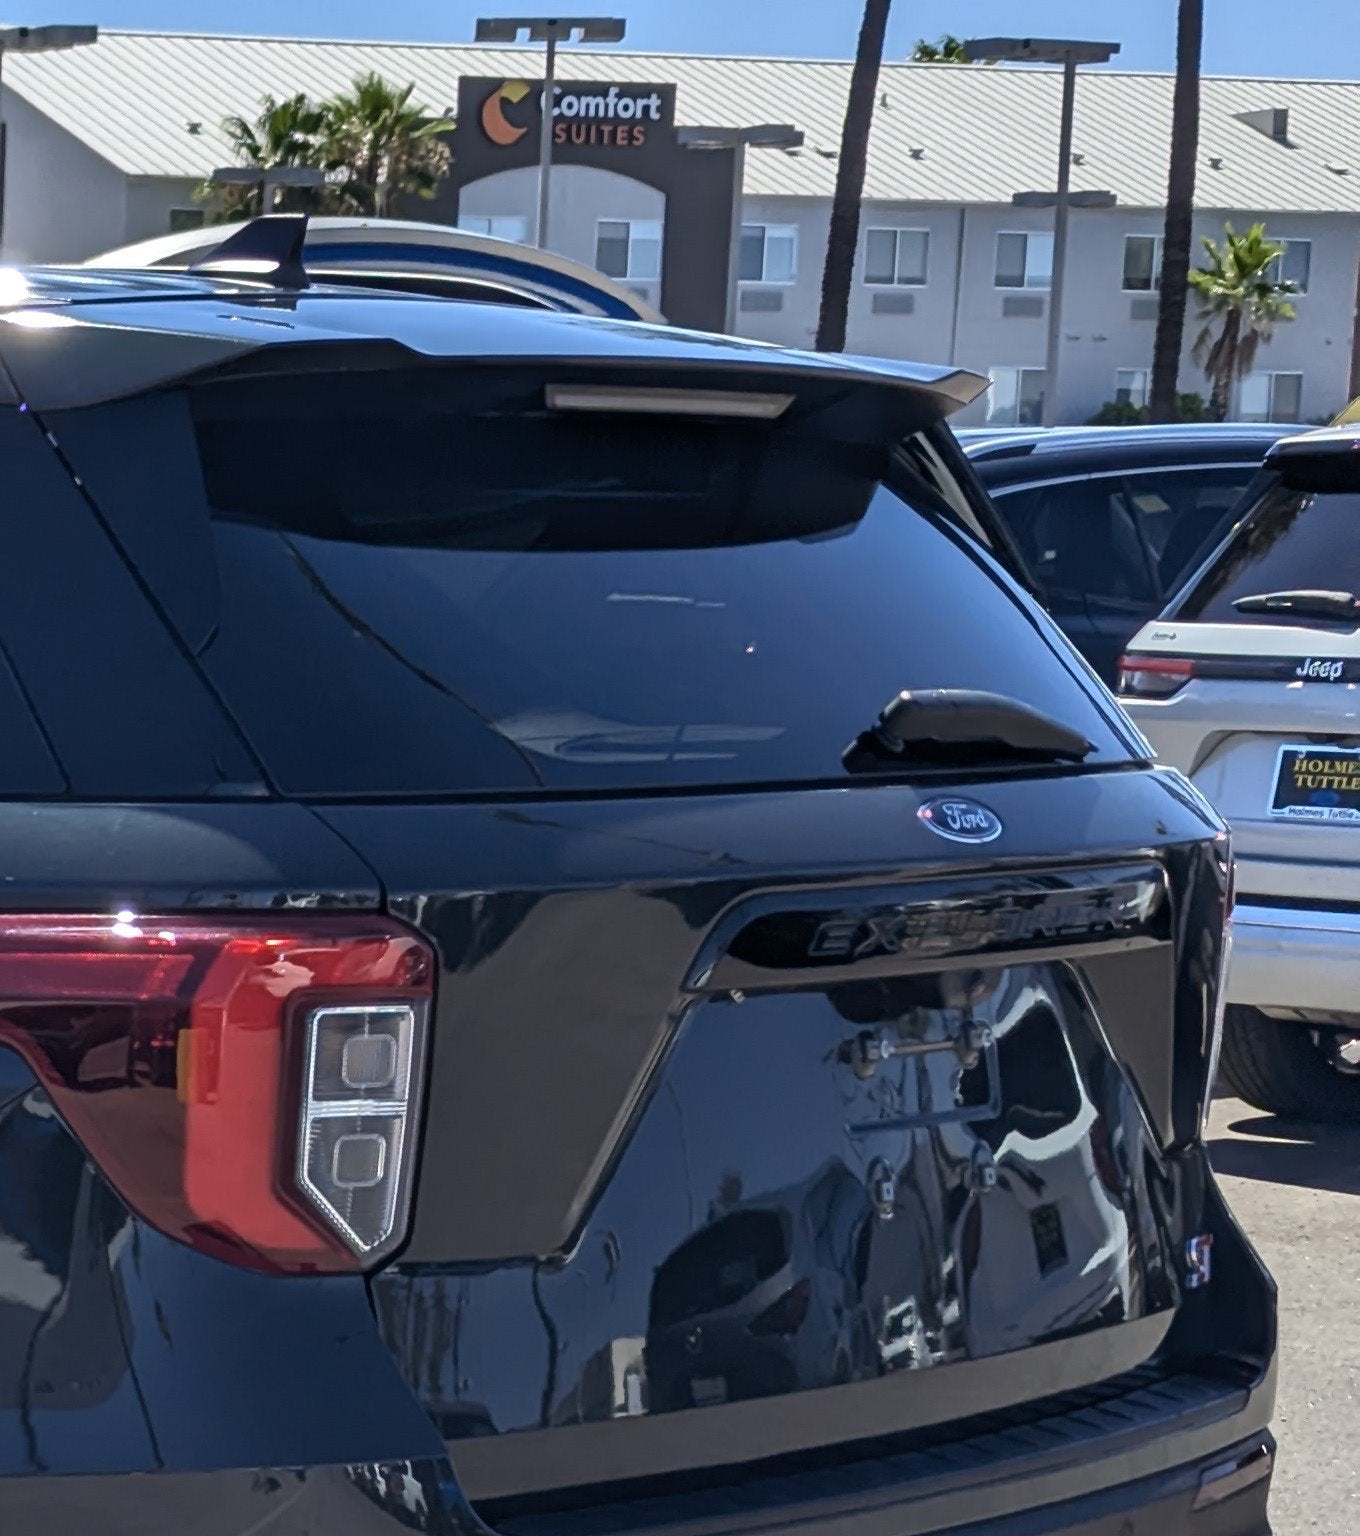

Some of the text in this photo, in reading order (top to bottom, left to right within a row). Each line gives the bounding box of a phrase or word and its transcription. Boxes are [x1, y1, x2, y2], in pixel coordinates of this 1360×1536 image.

[554, 122, 646, 146] SUITES
[1296, 657, 1344, 681] Jeep
[1294, 773, 1360, 790] TUTTLE
[942, 803, 989, 830] Ford
